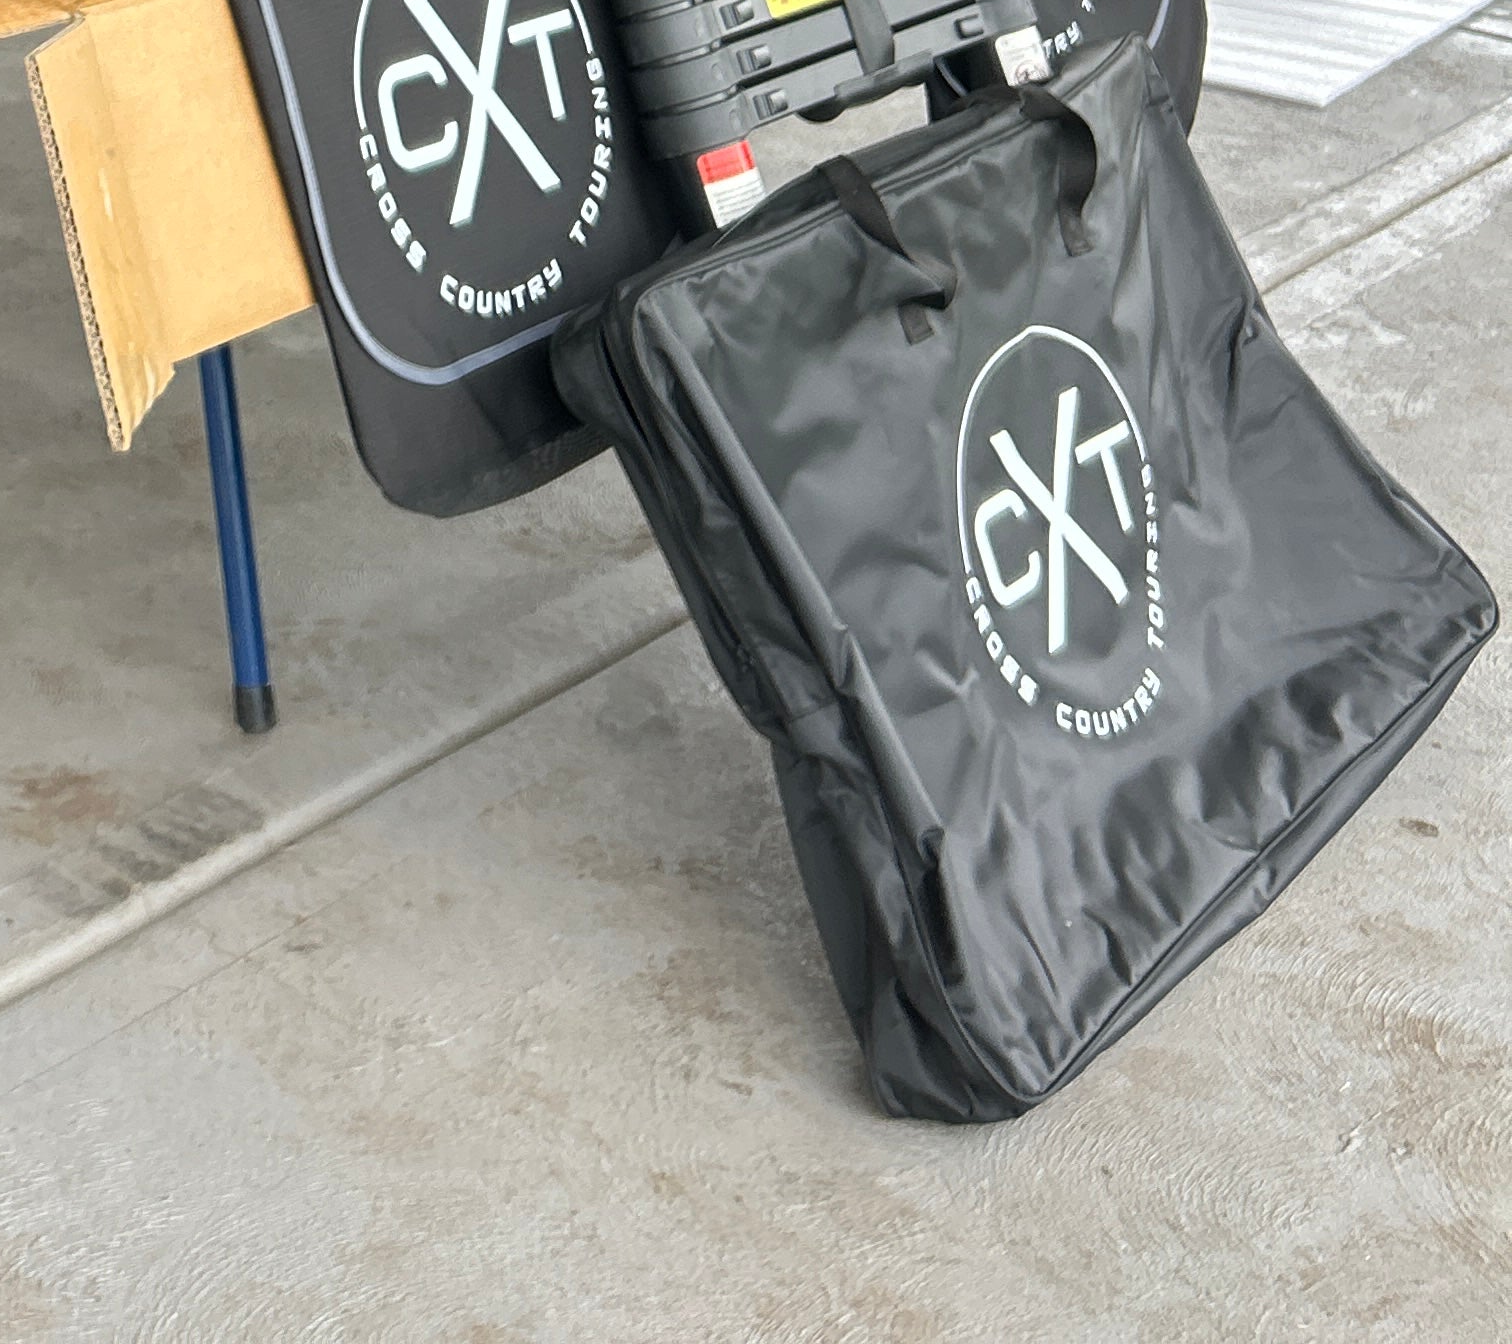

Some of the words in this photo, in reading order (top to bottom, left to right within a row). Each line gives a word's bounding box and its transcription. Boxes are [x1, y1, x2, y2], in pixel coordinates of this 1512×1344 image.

[359, 133, 428, 272] CROSS
[440, 257, 563, 317] COUNTRY
[569, 56, 613, 247] TOURING
[966, 575, 1040, 706] CROSS
[1055, 667, 1162, 738] COUNTRY
[1142, 462, 1168, 650] TOURING
[974, 386, 1133, 654] CXT
